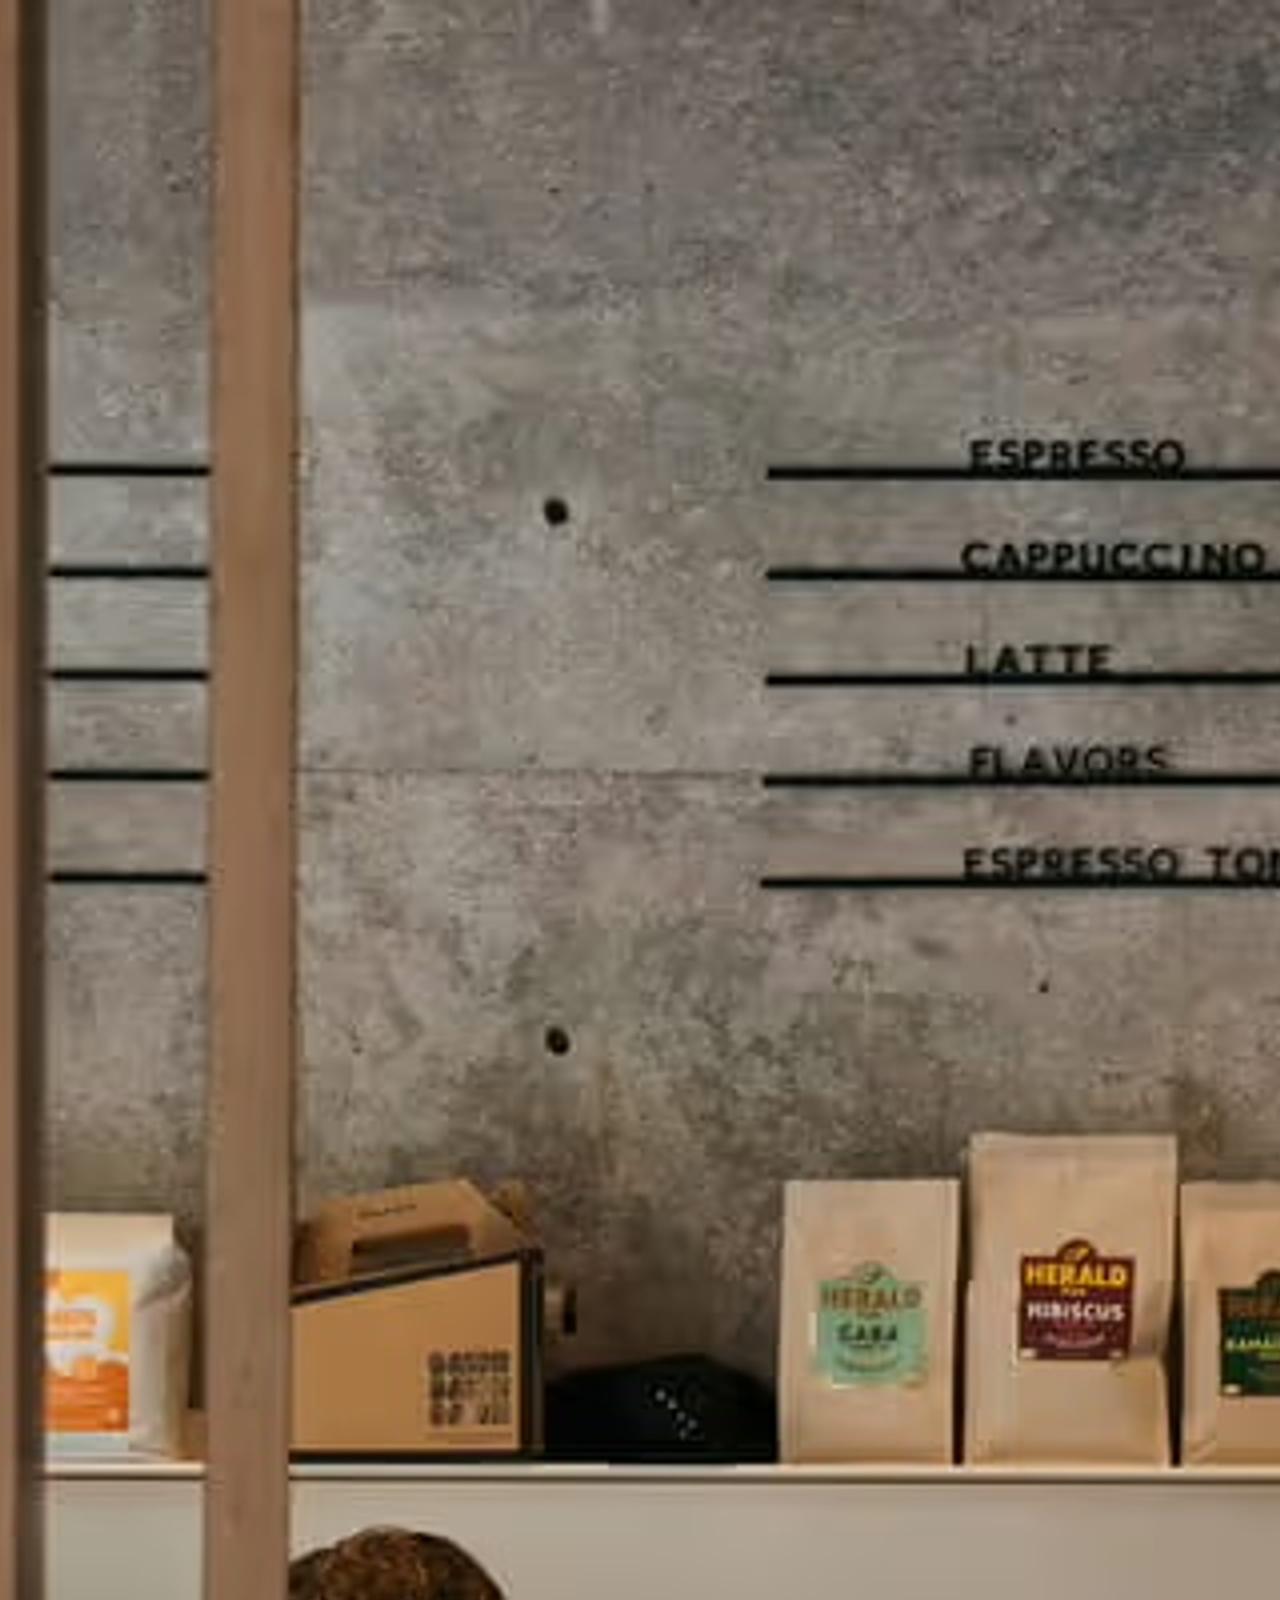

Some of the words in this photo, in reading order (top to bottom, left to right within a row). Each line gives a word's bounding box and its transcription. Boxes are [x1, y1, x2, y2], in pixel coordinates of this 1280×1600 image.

[969, 438, 1186, 474] ESPRESSO
[960, 542, 1267, 576] CAPPUCCINO
[964, 643, 1114, 675] LATTE
[969, 743, 1170, 778] FLAVORS
[962, 846, 1180, 880] ESPRESSO
[1023, 1262, 1128, 1288] HERALD
[820, 1286, 924, 1311] HERALD
[1027, 1301, 1125, 1321] HIBISCUS
